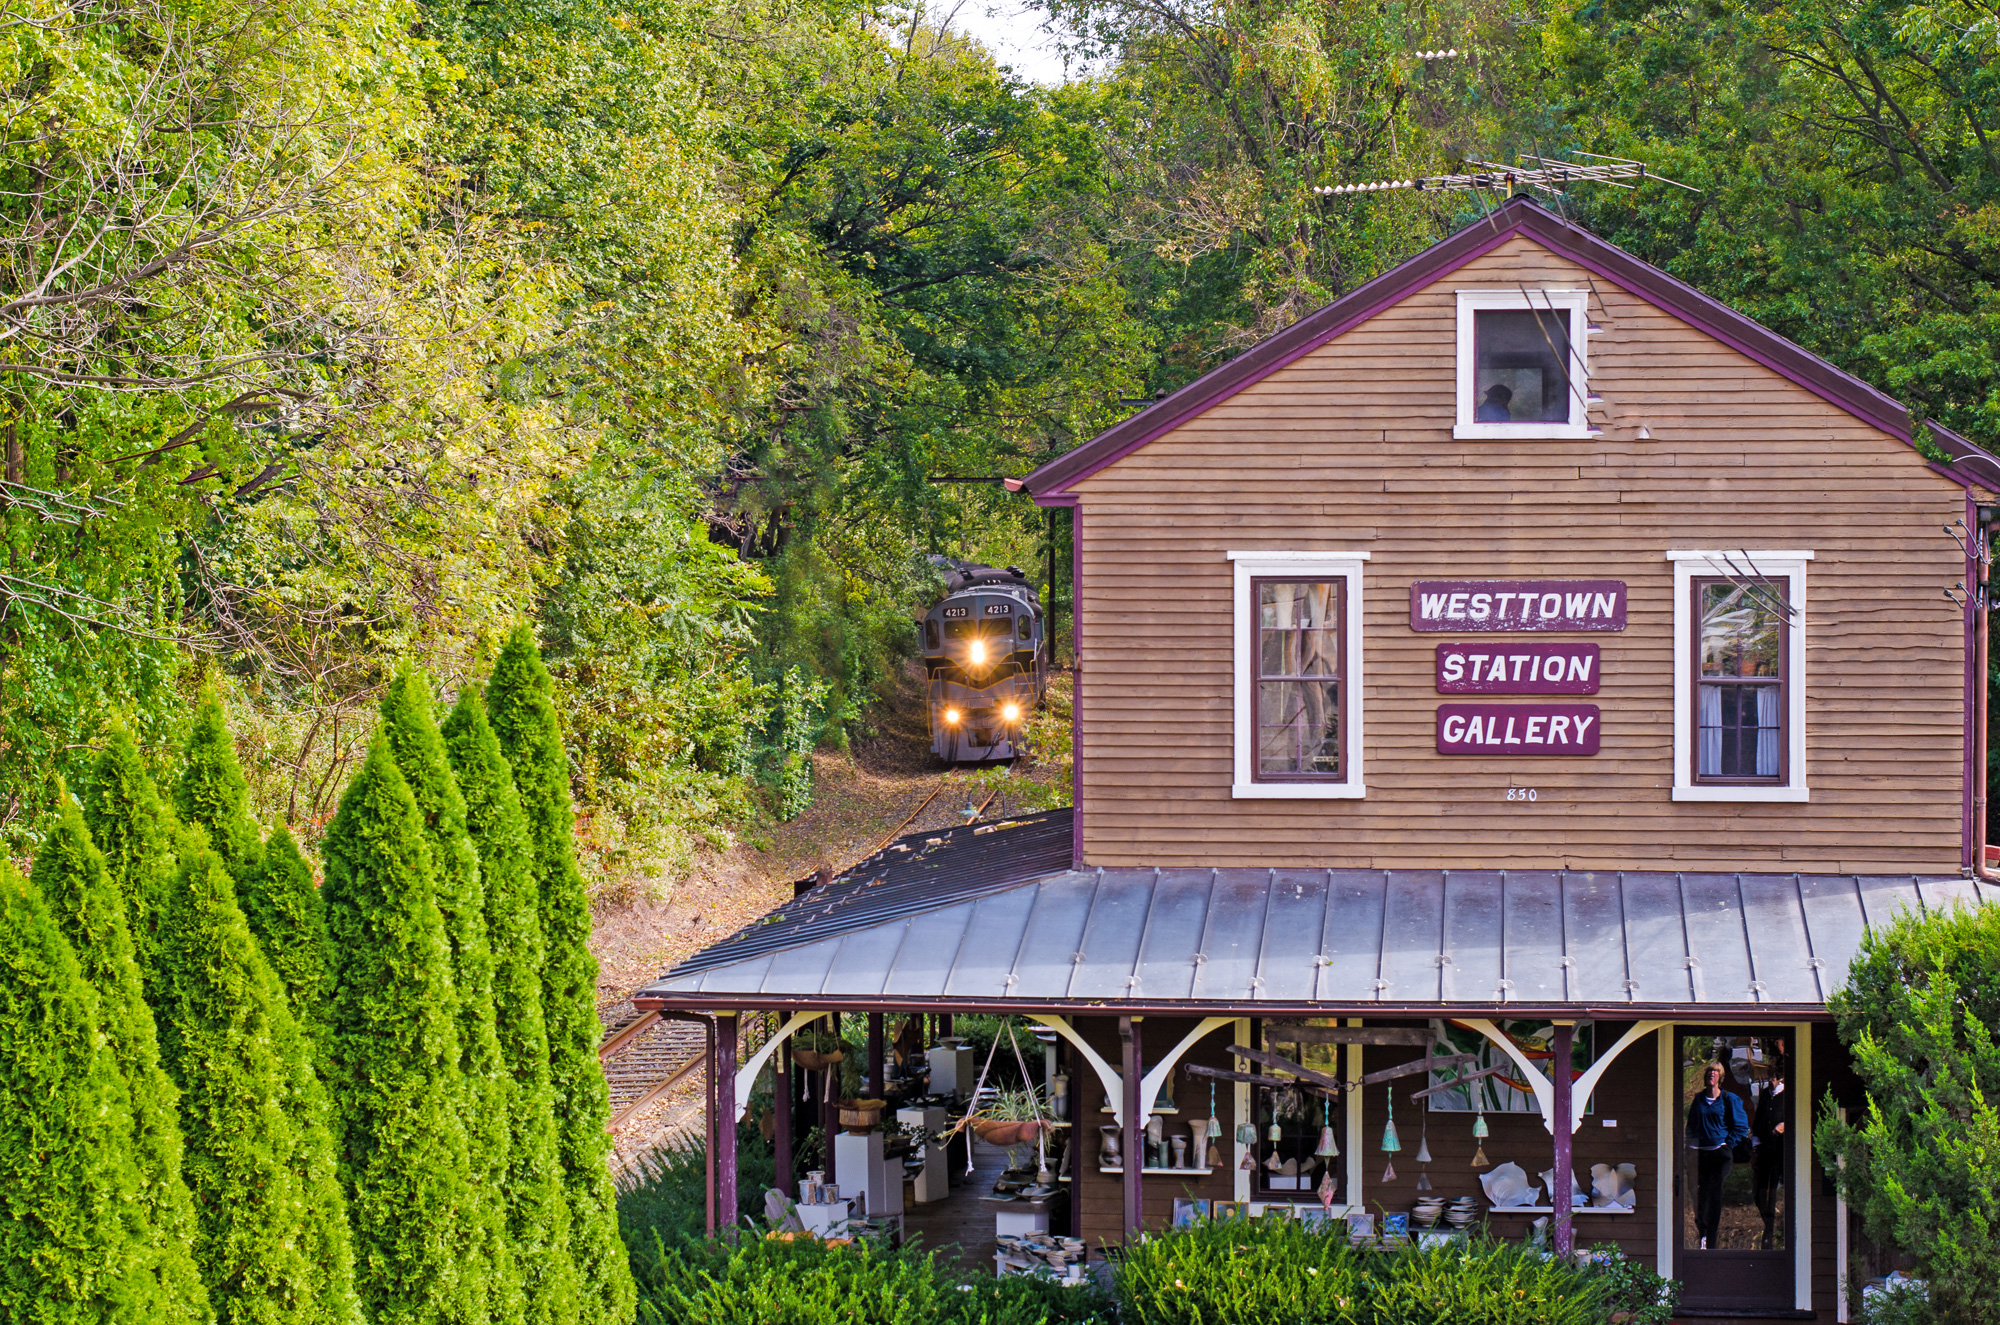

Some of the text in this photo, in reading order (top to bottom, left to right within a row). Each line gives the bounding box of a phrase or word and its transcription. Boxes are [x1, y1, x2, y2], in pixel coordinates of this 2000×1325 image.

[946, 608, 966, 617] 4213
[988, 605, 1009, 614] 4213
[1421, 593, 1617, 619] WESTTOWN
[1442, 654, 1593, 682] STATION
[1442, 715, 1594, 745] GALLERY
[1506, 788, 1537, 802] 850
